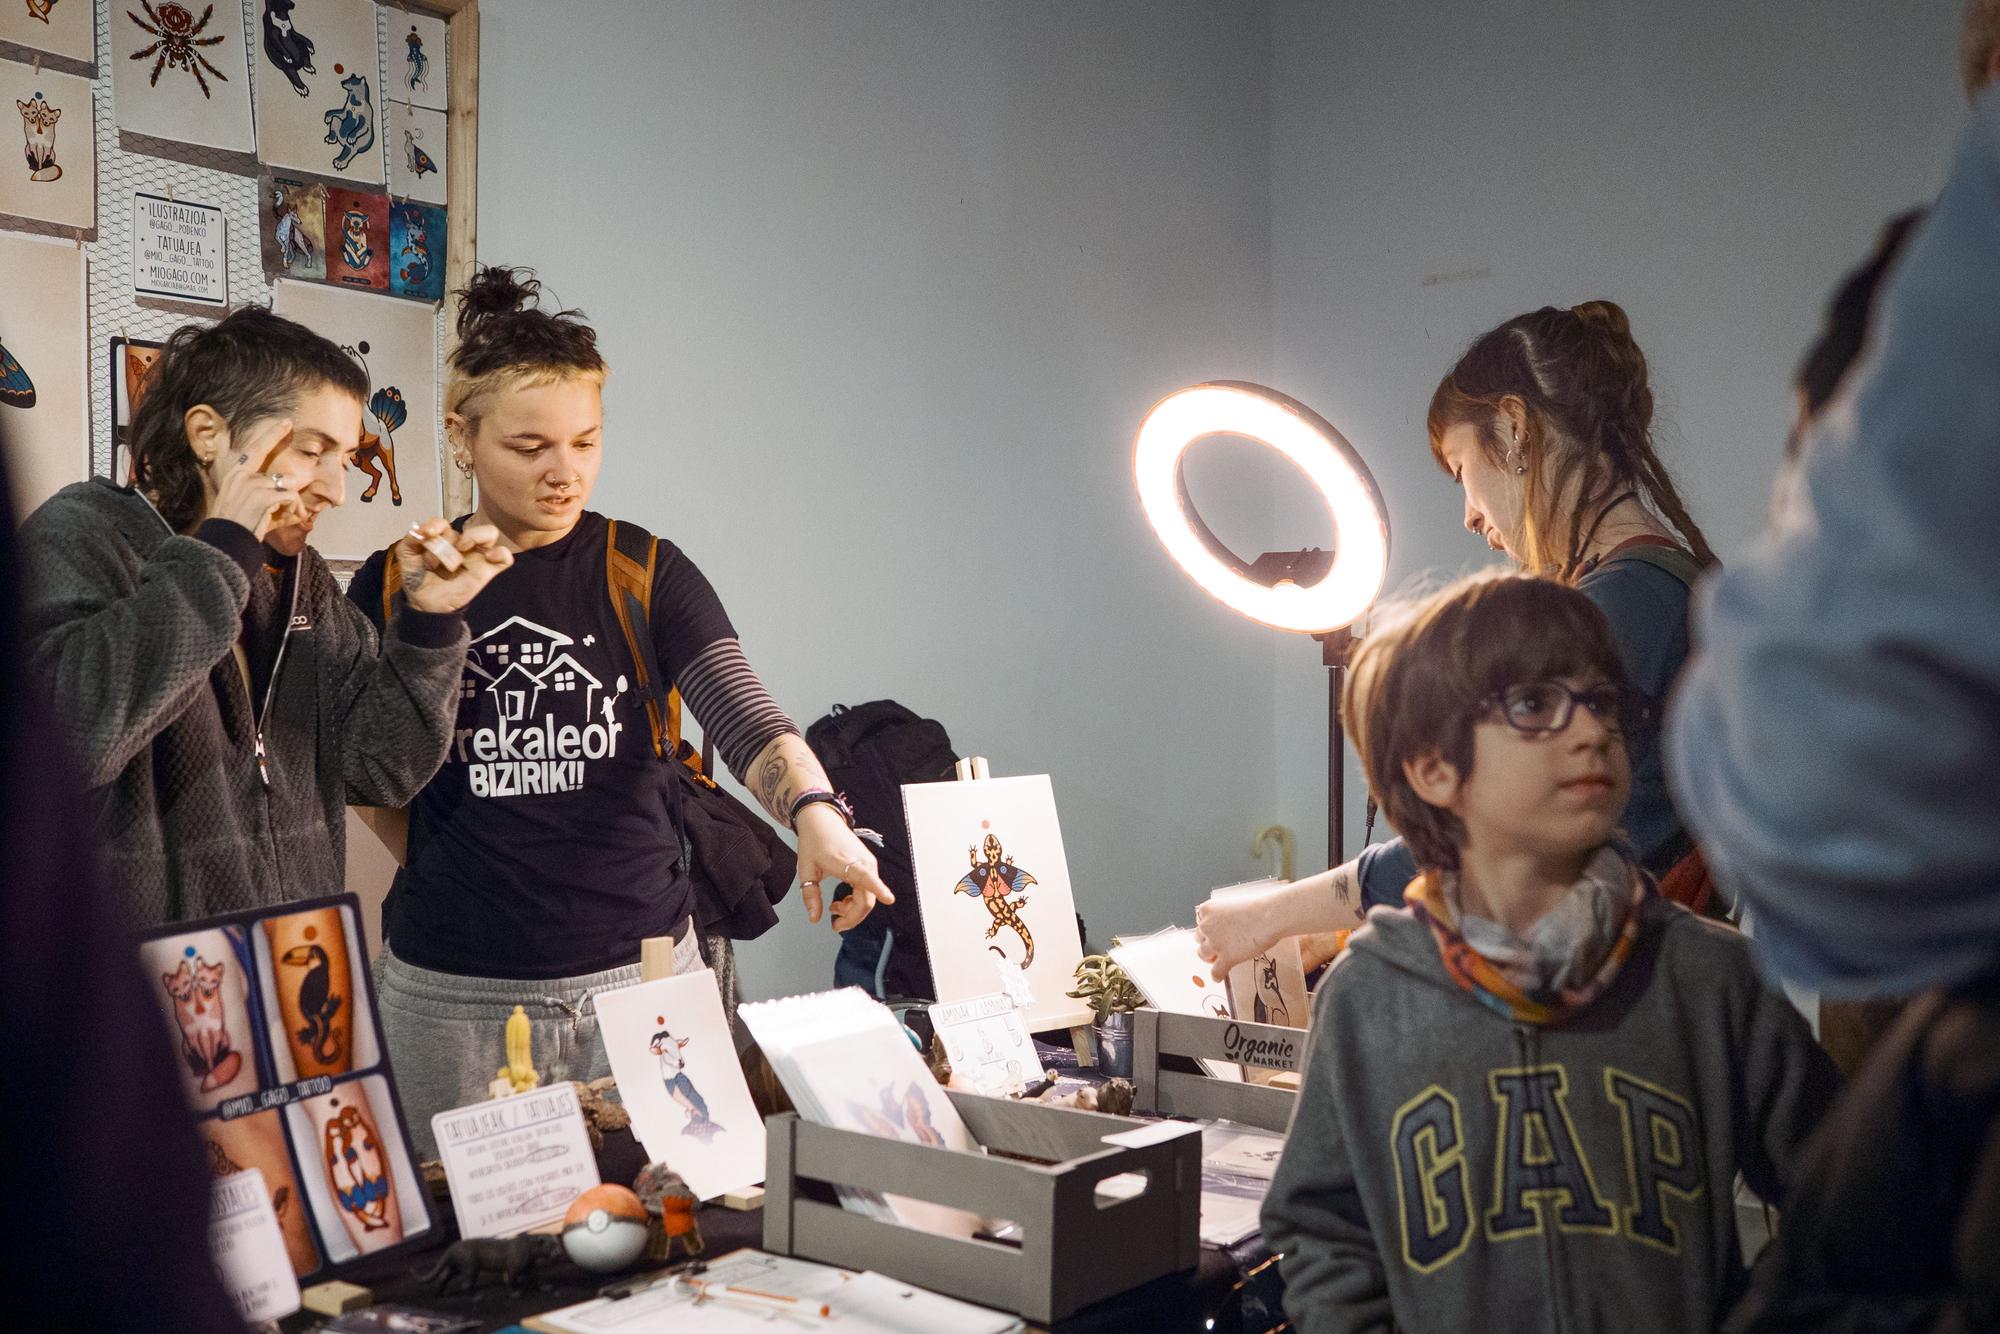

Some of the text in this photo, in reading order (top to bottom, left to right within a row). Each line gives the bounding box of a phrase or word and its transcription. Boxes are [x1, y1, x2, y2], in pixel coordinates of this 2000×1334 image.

[149, 203, 206, 226] ILUSTRAZIOA
[149, 220, 206, 237] @GAGO_PODENCO
[157, 236, 201, 256] TATUAJEA
[144, 250, 214, 269] @MIO_GAGO_TATTOO
[150, 266, 209, 286] MIOGAGO.COM
[445, 713, 623, 764] rekaleor
[469, 761, 585, 798] BIZIRIK!!
[1224, 1023, 1294, 1062] Organic
[1253, 1056, 1294, 1068] MARKET
[1390, 1063, 1701, 1275] GAP
